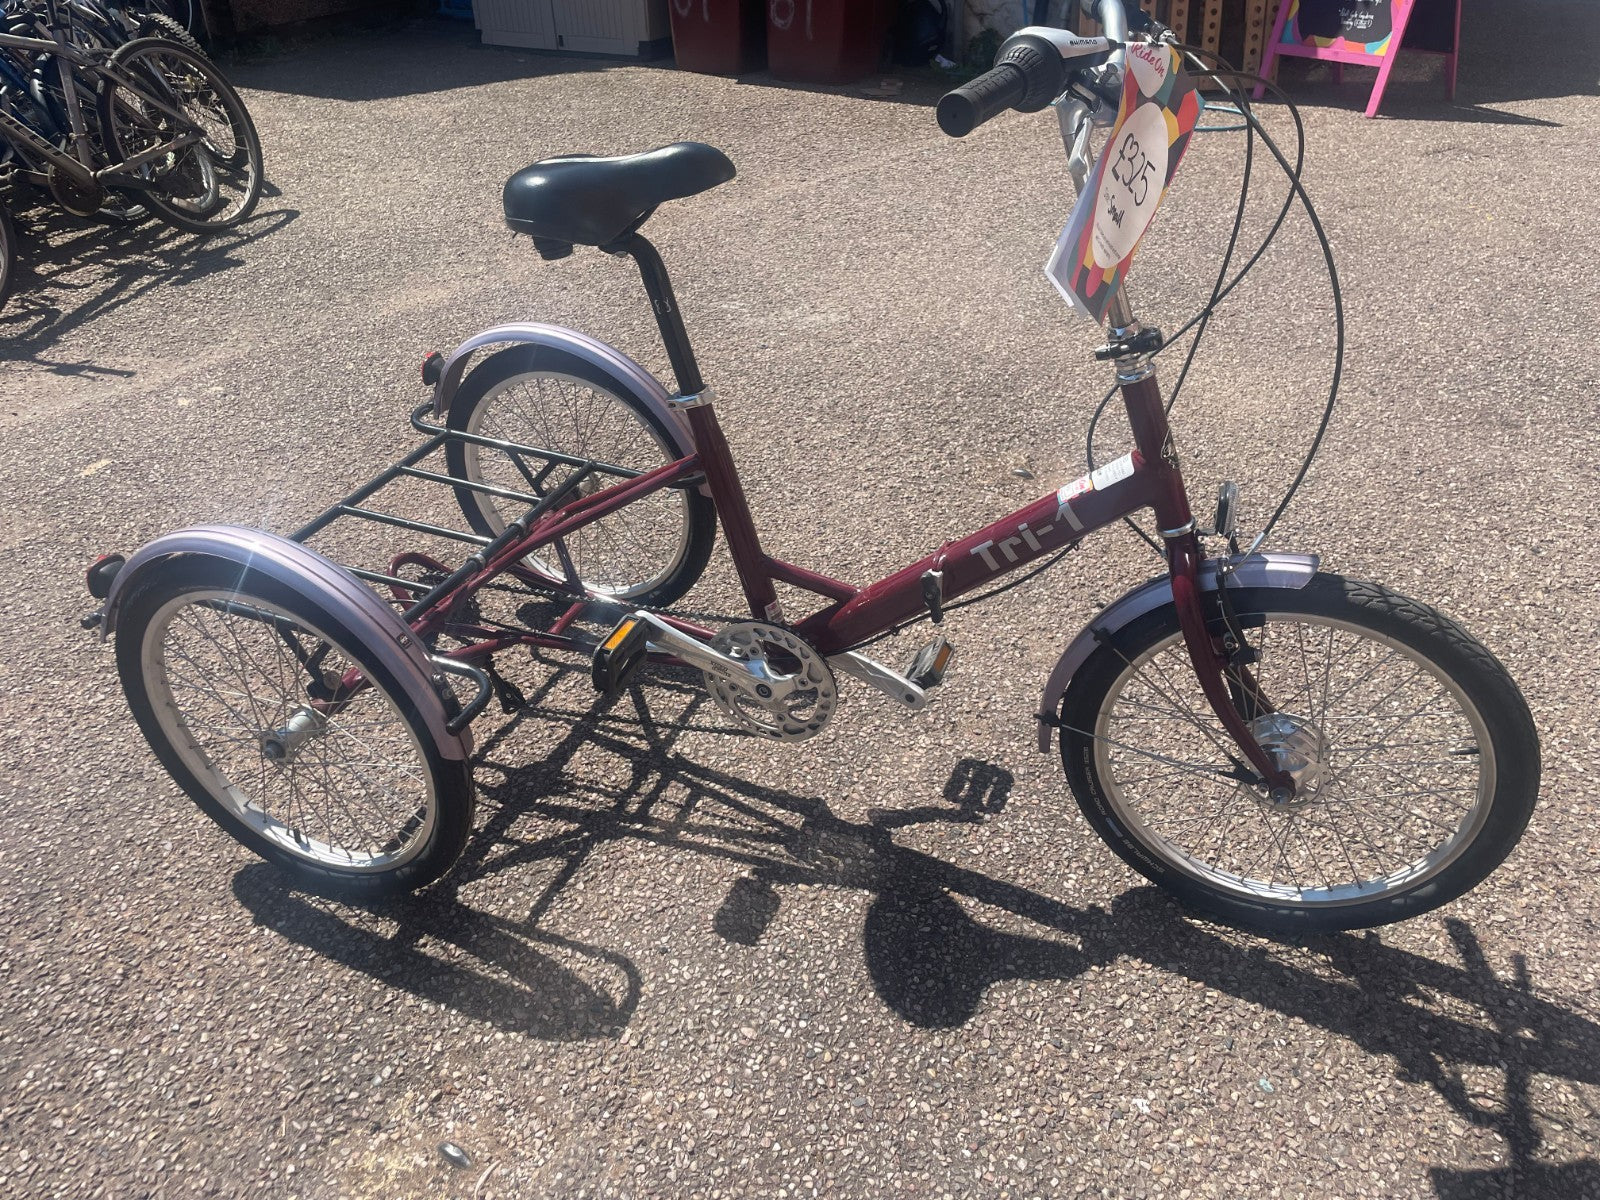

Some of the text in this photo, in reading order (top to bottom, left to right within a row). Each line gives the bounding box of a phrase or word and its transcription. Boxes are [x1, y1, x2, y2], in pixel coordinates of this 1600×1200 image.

[1131, 42, 1165, 77] Ride On
[1111, 132, 1156, 207] £325
[969, 502, 1085, 572] Tri-1
